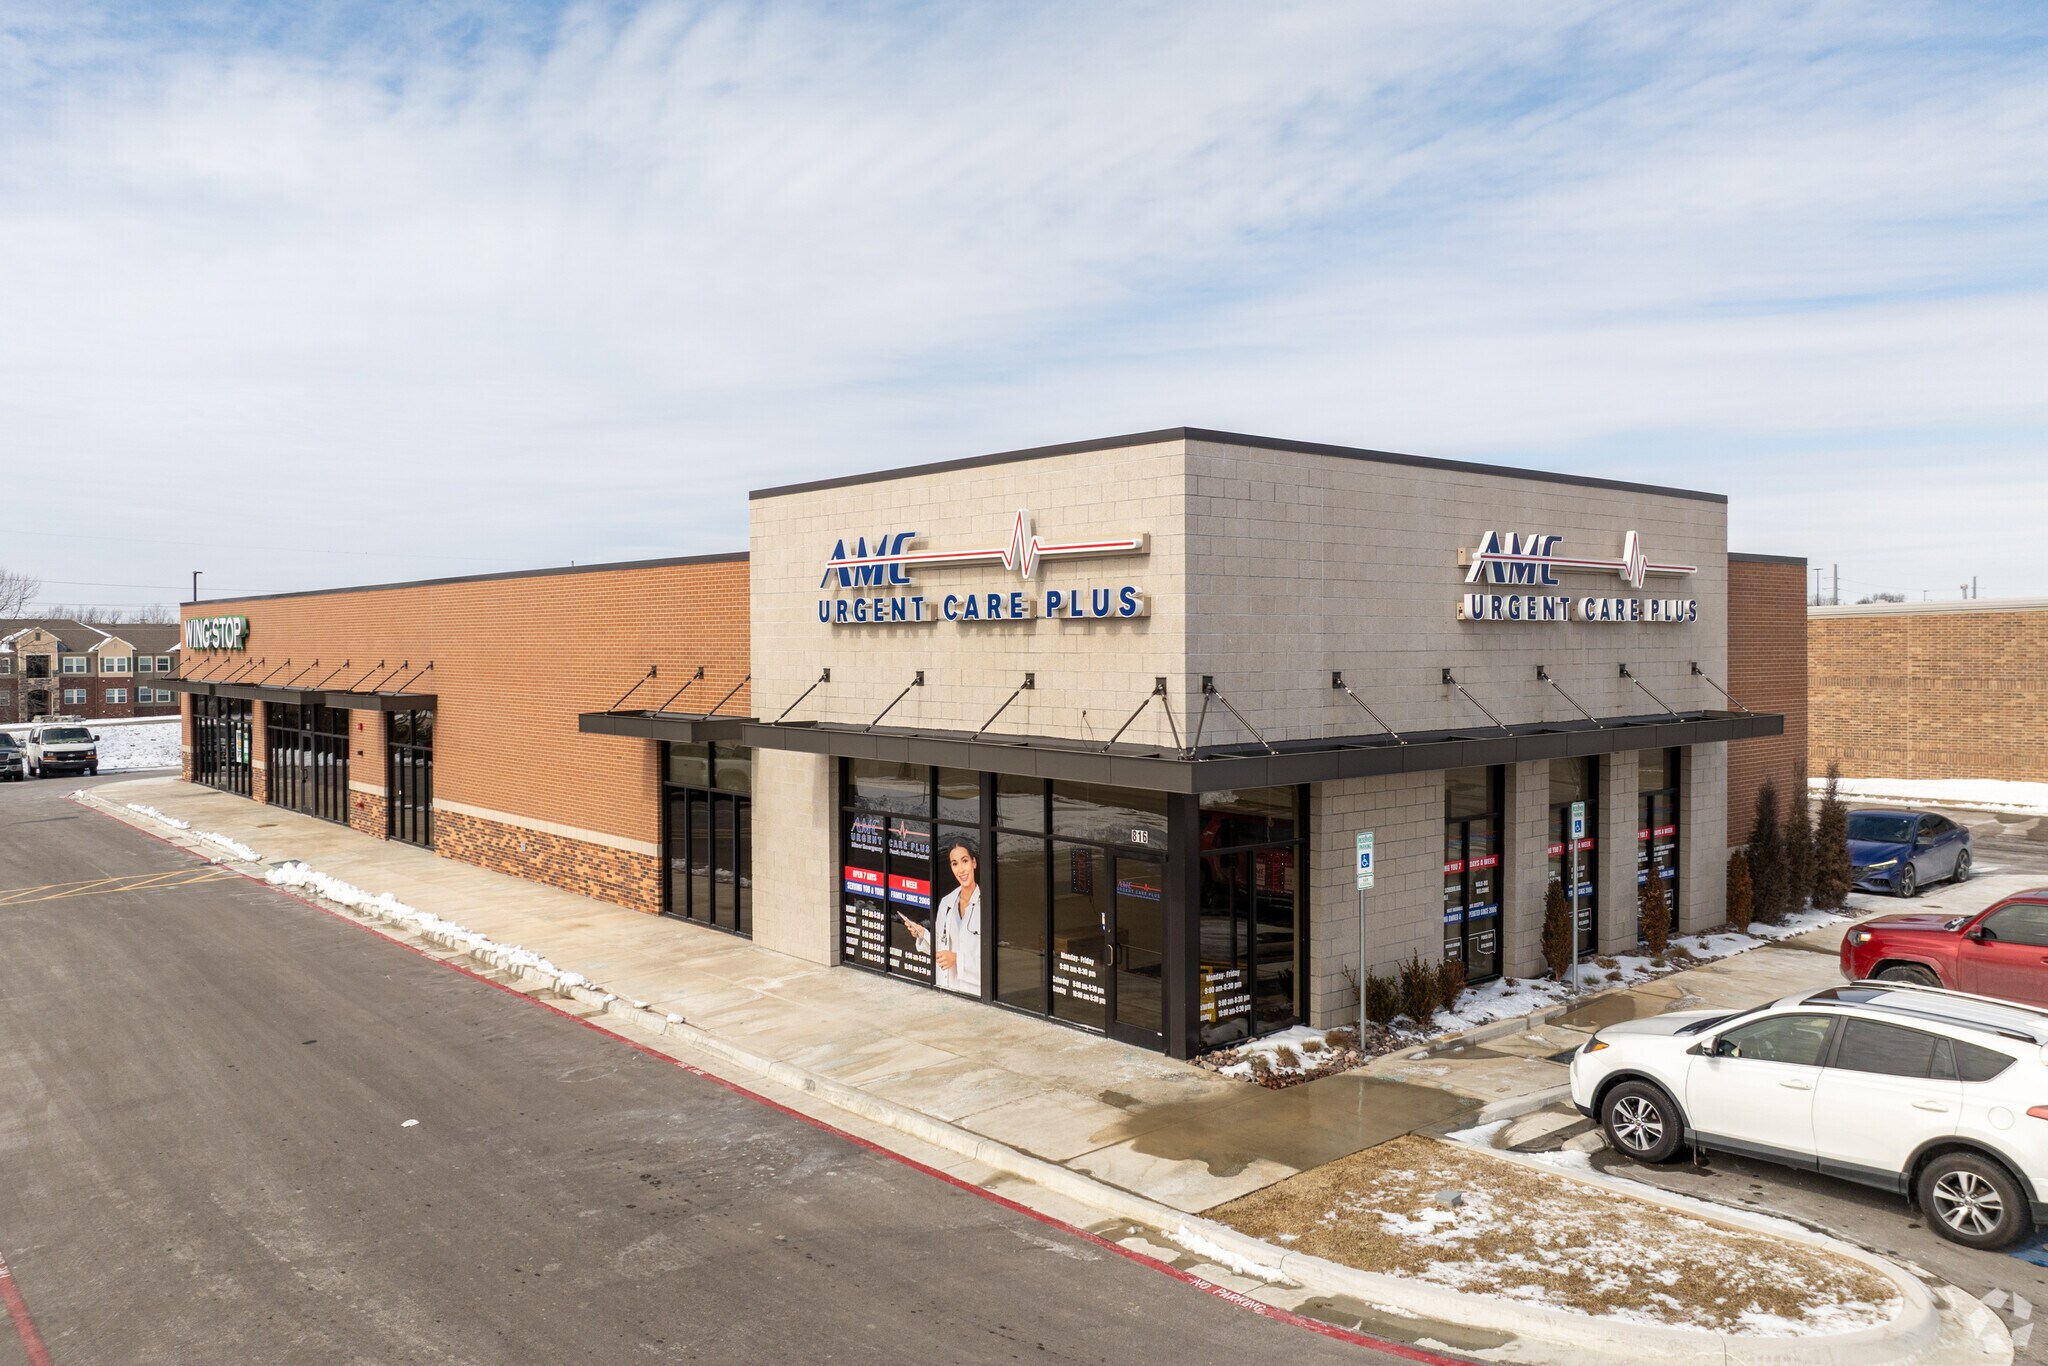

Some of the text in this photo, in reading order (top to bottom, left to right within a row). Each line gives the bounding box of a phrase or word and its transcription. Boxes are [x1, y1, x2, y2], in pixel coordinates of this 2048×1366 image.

[820, 532, 916, 589] AMC
[1465, 530, 1563, 586] AMC
[818, 586, 1141, 624] URGENT CARE PLUS
[1466, 594, 1698, 623] URGENT CARE PLUS
[1132, 830, 1147, 843] 816
[850, 833, 930, 854] URGENT CARE PLUS
[1484, 857, 1495, 865] WEEK
[1080, 956, 1094, 966] Friday
[1226, 969, 1240, 978] Friday
[1234, 981, 1242, 989] pm
[1243, 994, 1250, 1002] pm
[1244, 1004, 1251, 1012] pm
[1190, 1279, 1267, 1313] NO PARKING
